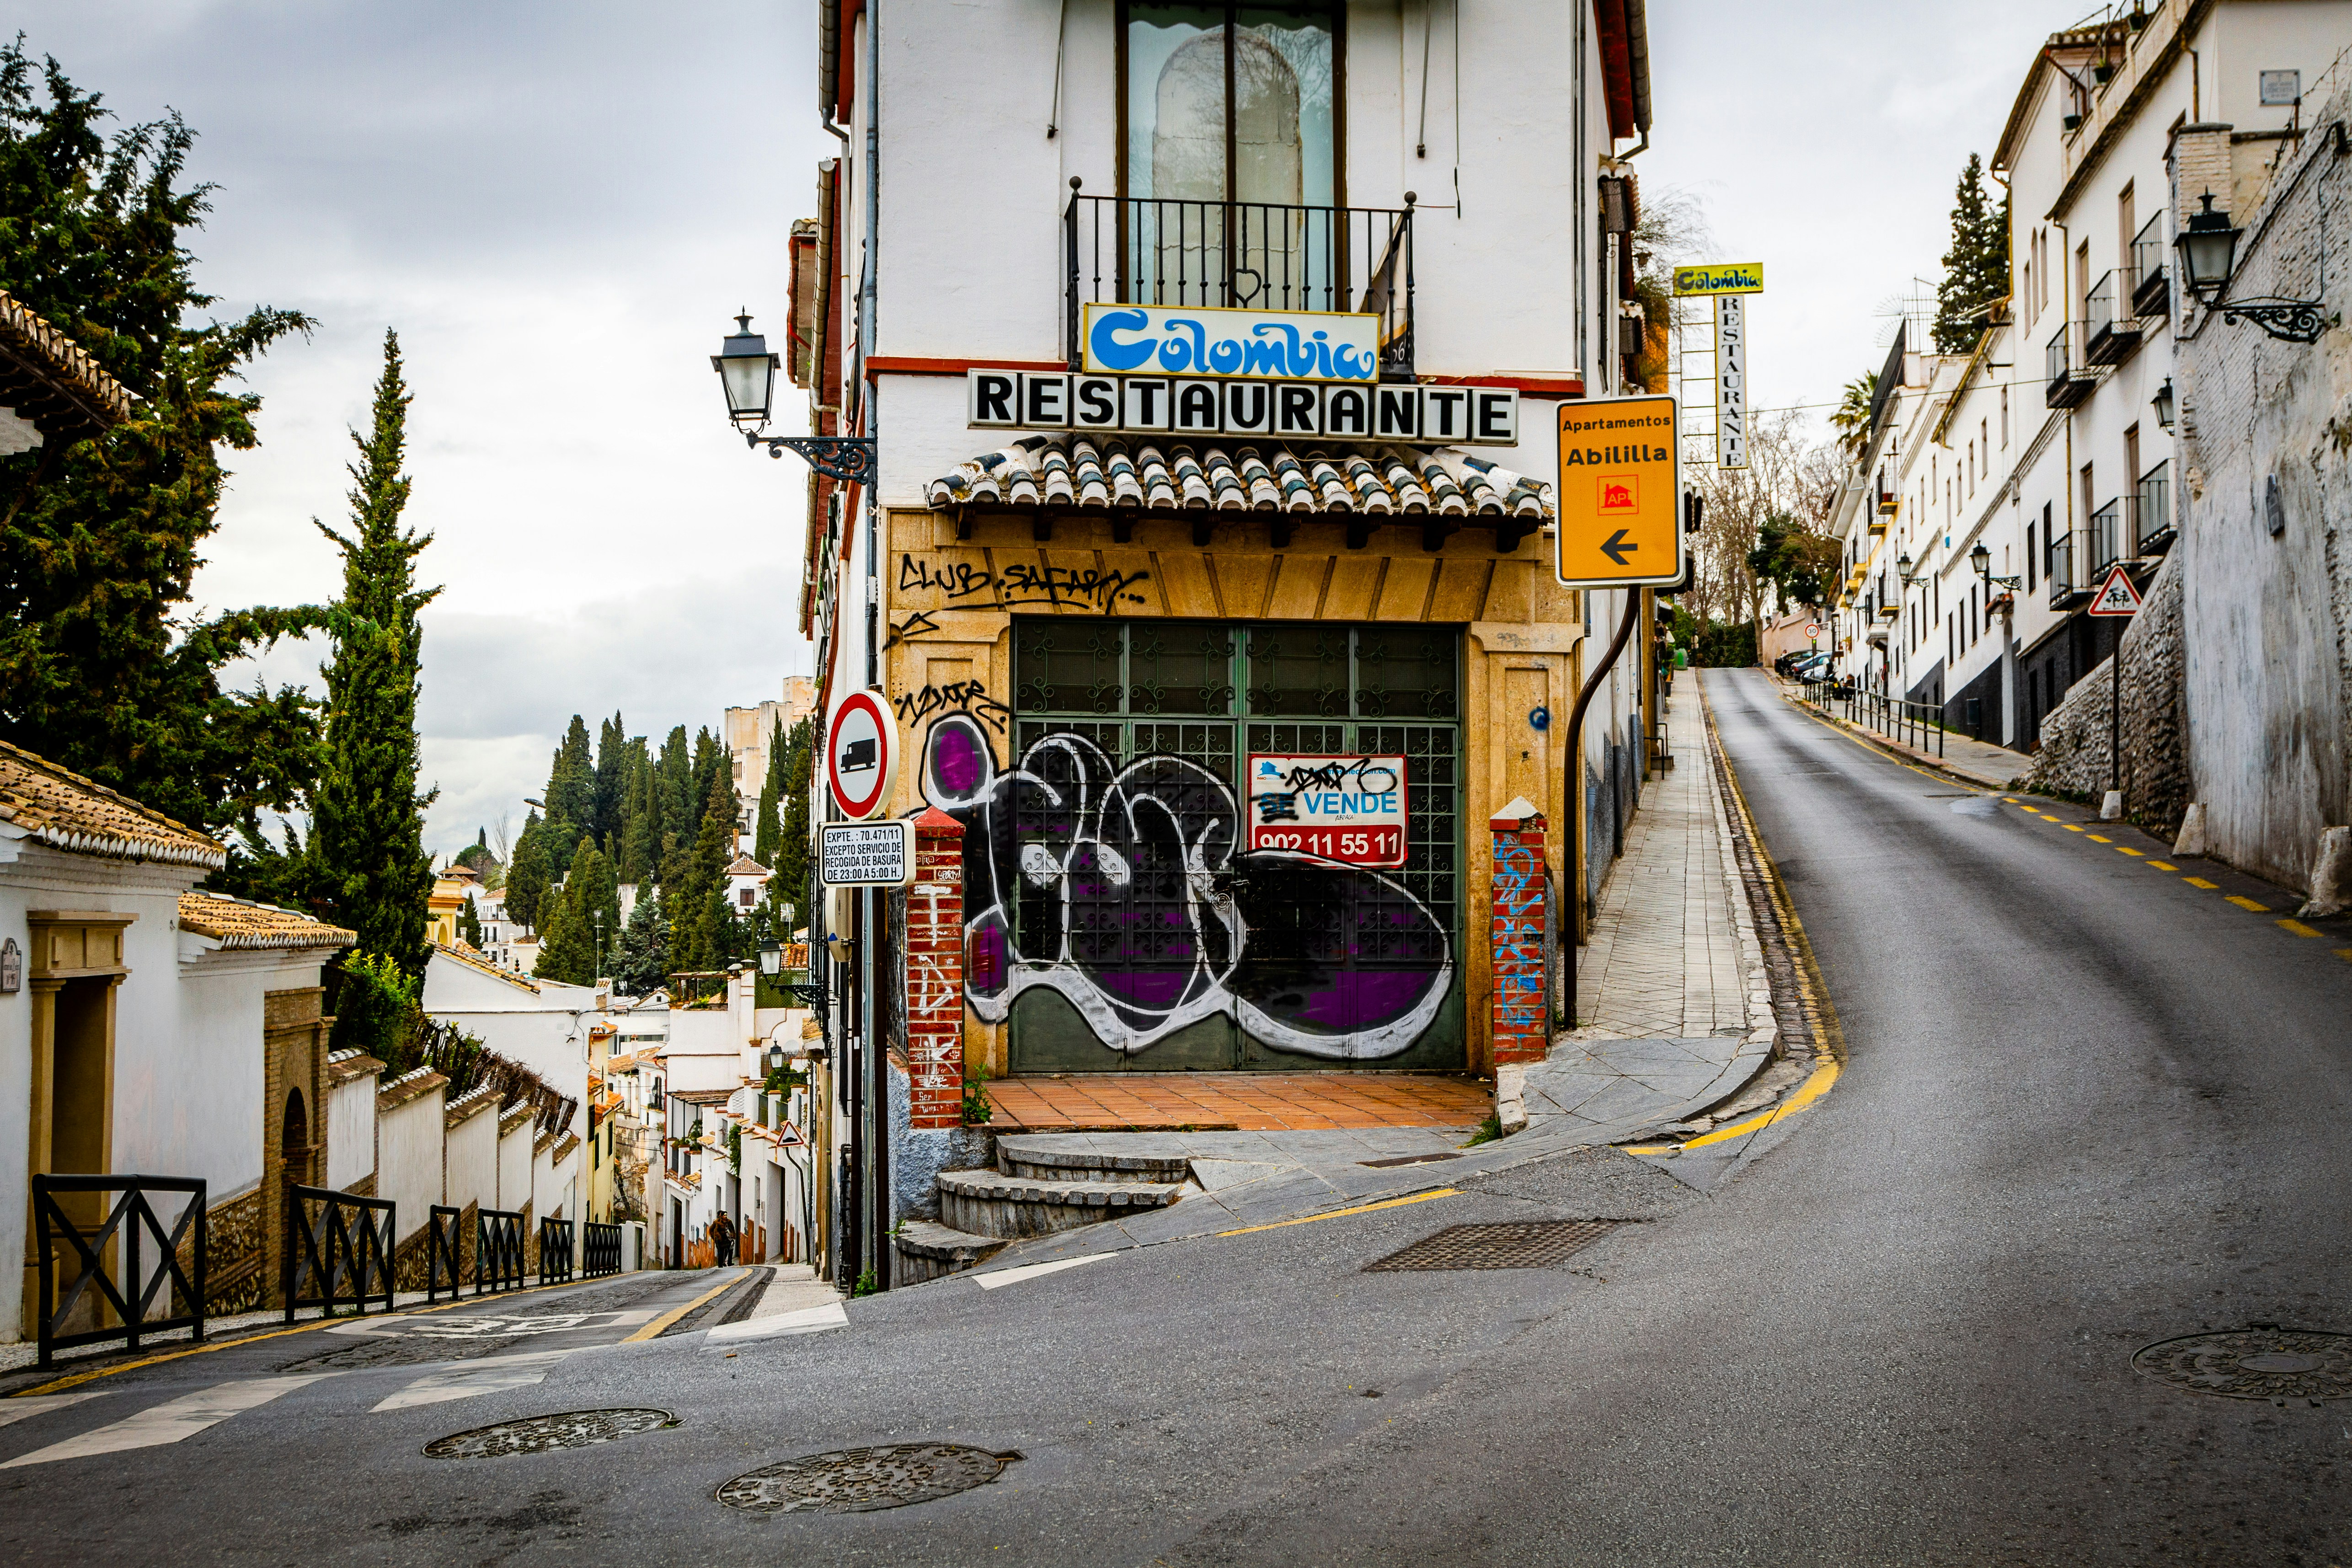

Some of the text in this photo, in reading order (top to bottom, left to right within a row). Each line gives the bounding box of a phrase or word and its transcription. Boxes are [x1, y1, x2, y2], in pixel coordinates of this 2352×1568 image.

[1677, 269, 1761, 291] Colombia
[1090, 309, 1375, 379] Colombia
[1721, 298, 1742, 467] RESTAURANTE
[977, 375, 1512, 438] RESTAURANTE
[1563, 416, 1671, 433] Apartamentos
[1566, 444, 1668, 466] Abililla
[1304, 792, 1398, 814] VENDE
[827, 832, 853, 843] EXPTE.
[860, 829, 898, 841] 70.471/11
[1308, 834, 1332, 855] 11
[1341, 834, 1369, 855] 55
[1374, 833, 1398, 854] 11
[825, 842, 901, 856] EXCEPTO SERVICIO DE
[826, 854, 901, 867] RECOGIDA DE BASURA
[828, 867, 900, 880] DE 23:00 A 5:00 H.
